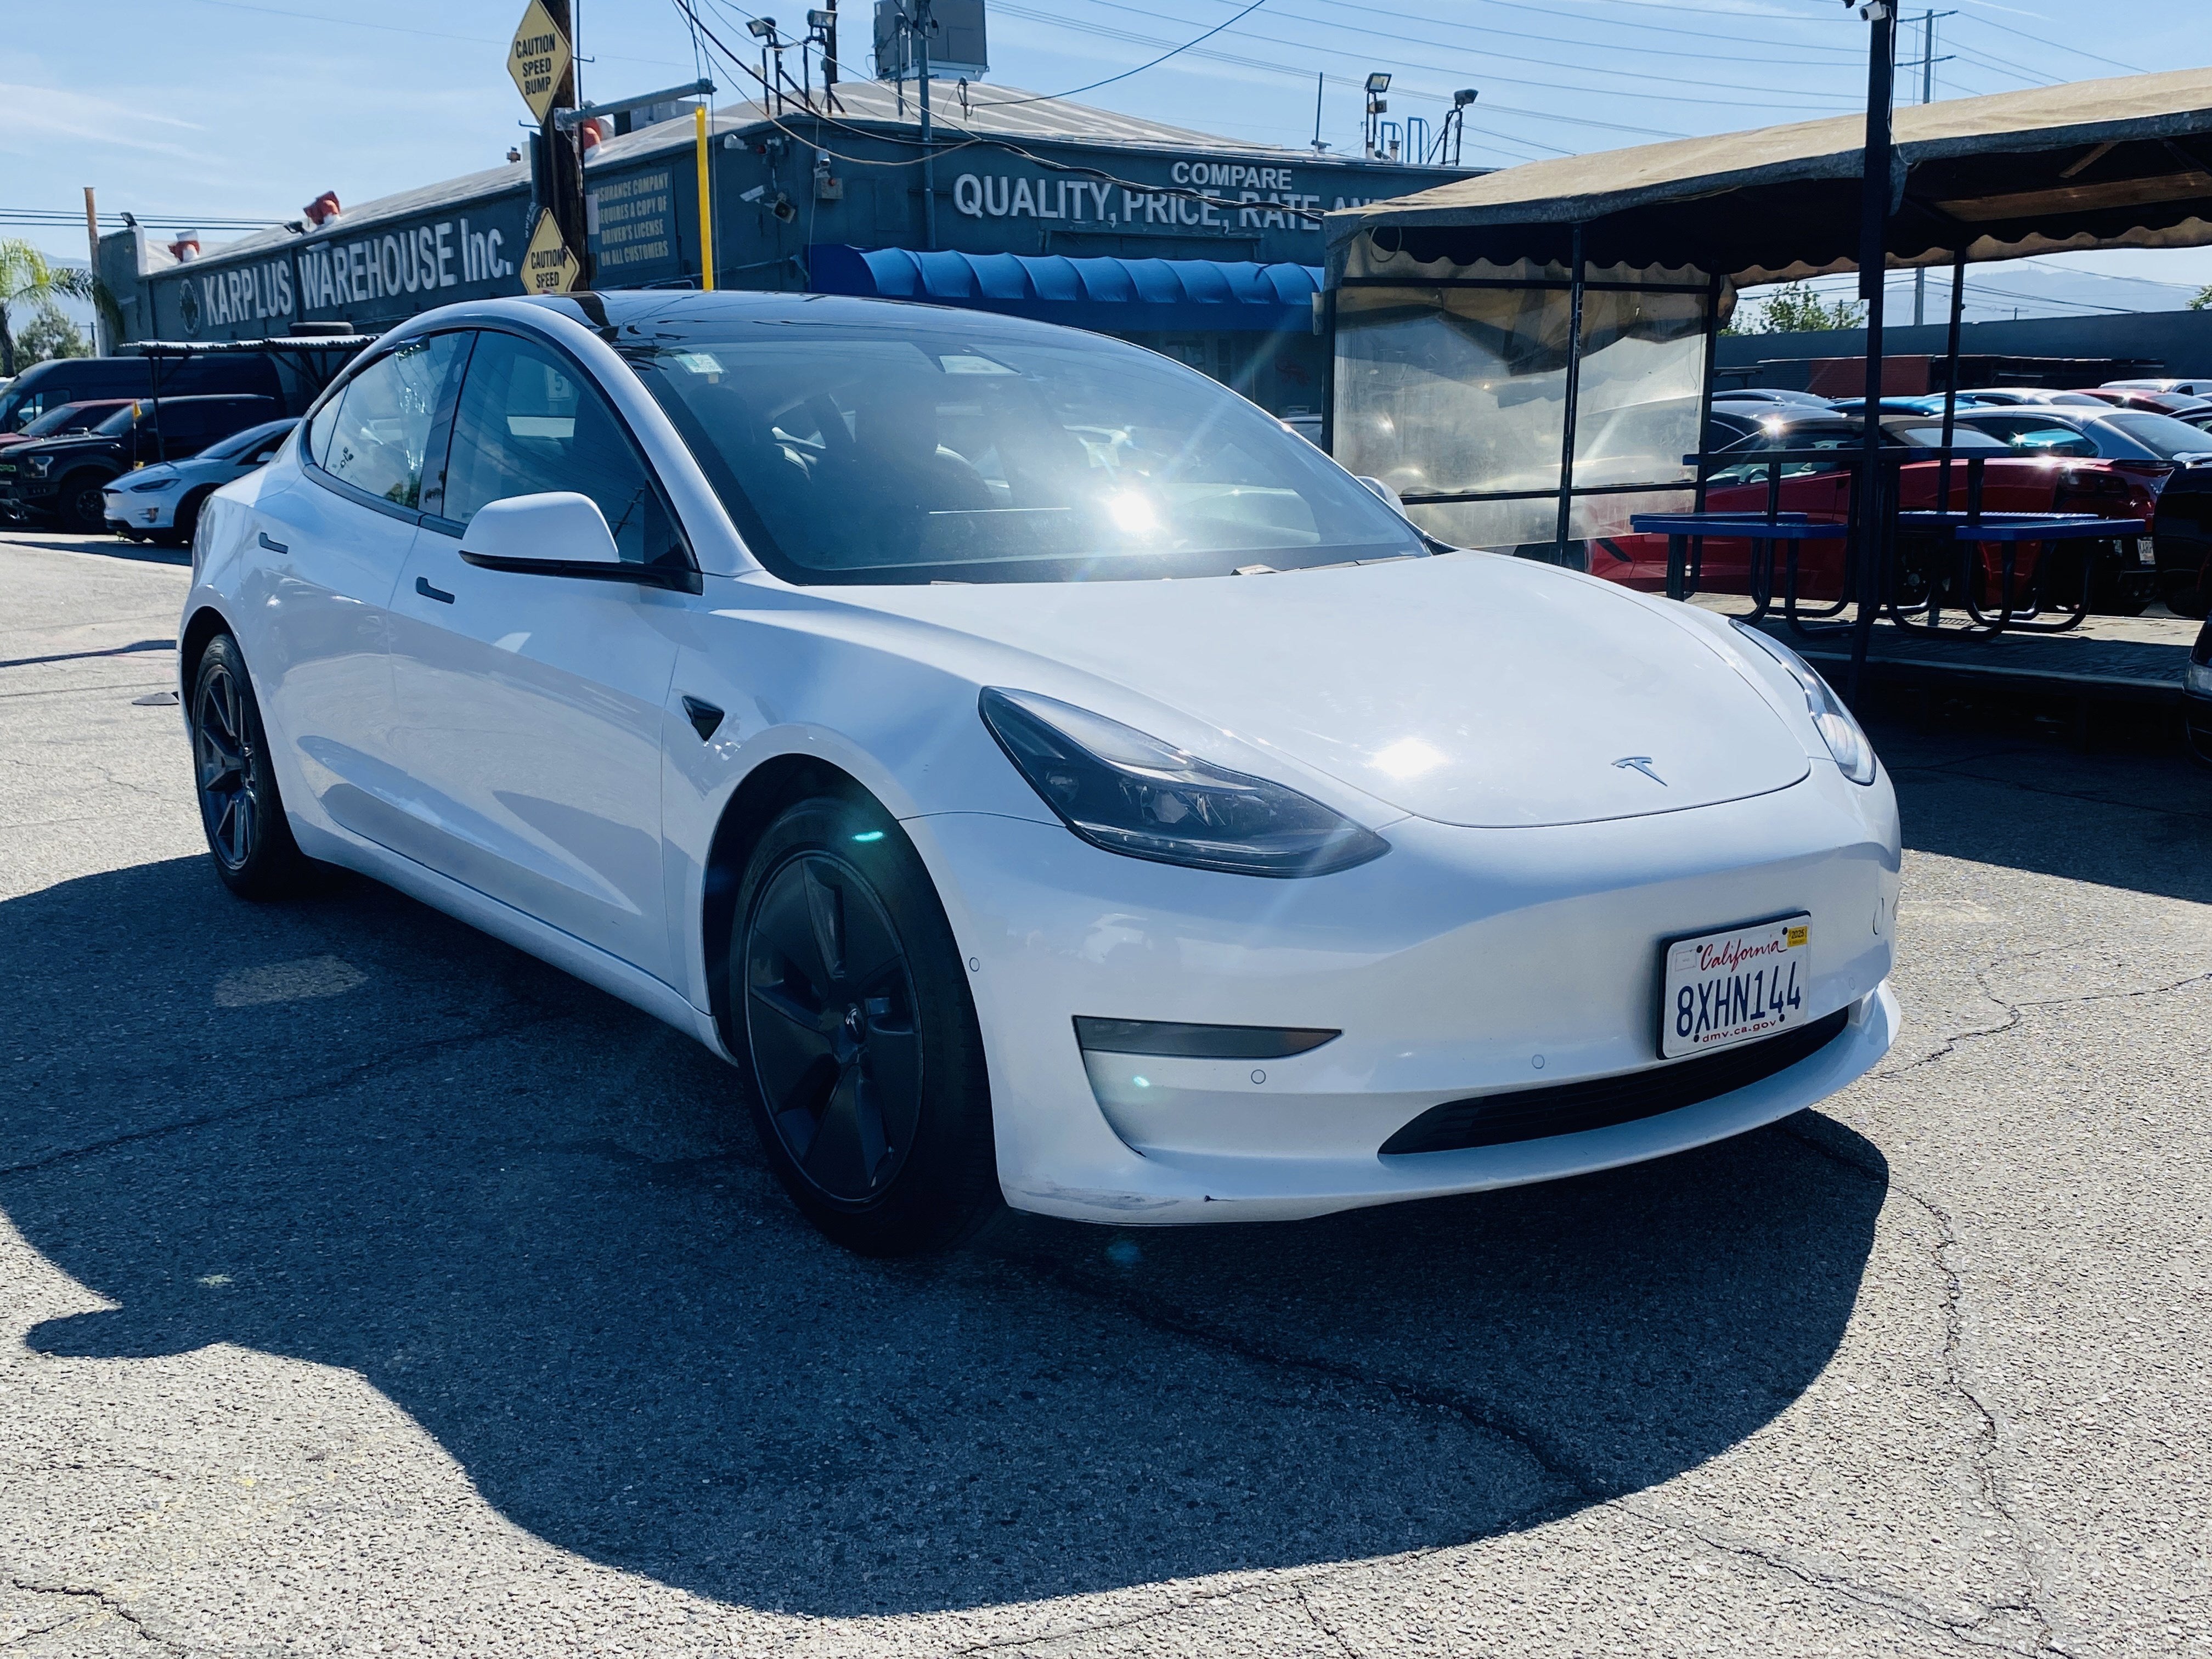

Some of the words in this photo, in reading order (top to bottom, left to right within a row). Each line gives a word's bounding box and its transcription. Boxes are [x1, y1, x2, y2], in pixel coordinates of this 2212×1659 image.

[516, 33, 555, 59] CAUTION
[522, 57, 551, 77] SPEED
[525, 76, 551, 95] BUMP
[633, 172, 669, 195] COMPANY
[1170, 161, 1293, 191] COMPARE
[598, 204, 629, 224] EQUIRES
[630, 202, 636, 218] A
[636, 197, 656, 216] COPY
[657, 195, 667, 212] OF
[953, 173, 1117, 229] QUALITY,
[1238, 190, 1320, 230] RATE
[601, 224, 633, 245] DRIVER'S
[634, 219, 664, 239] LICENSE
[531, 249, 565, 269] CAUTION
[601, 251, 611, 267] ON
[612, 248, 624, 265] ALL
[624, 240, 669, 263] CUSTOMERS
[202, 260, 292, 326] KARPLUS
[298, 222, 458, 311] WAREHOUSE
[461, 218, 514, 283] Inc.
[1700, 935, 1788, 972] California
[1677, 961, 1801, 1037] 8XHN144
[1702, 1020, 1776, 1043] dmv.ca.gov
